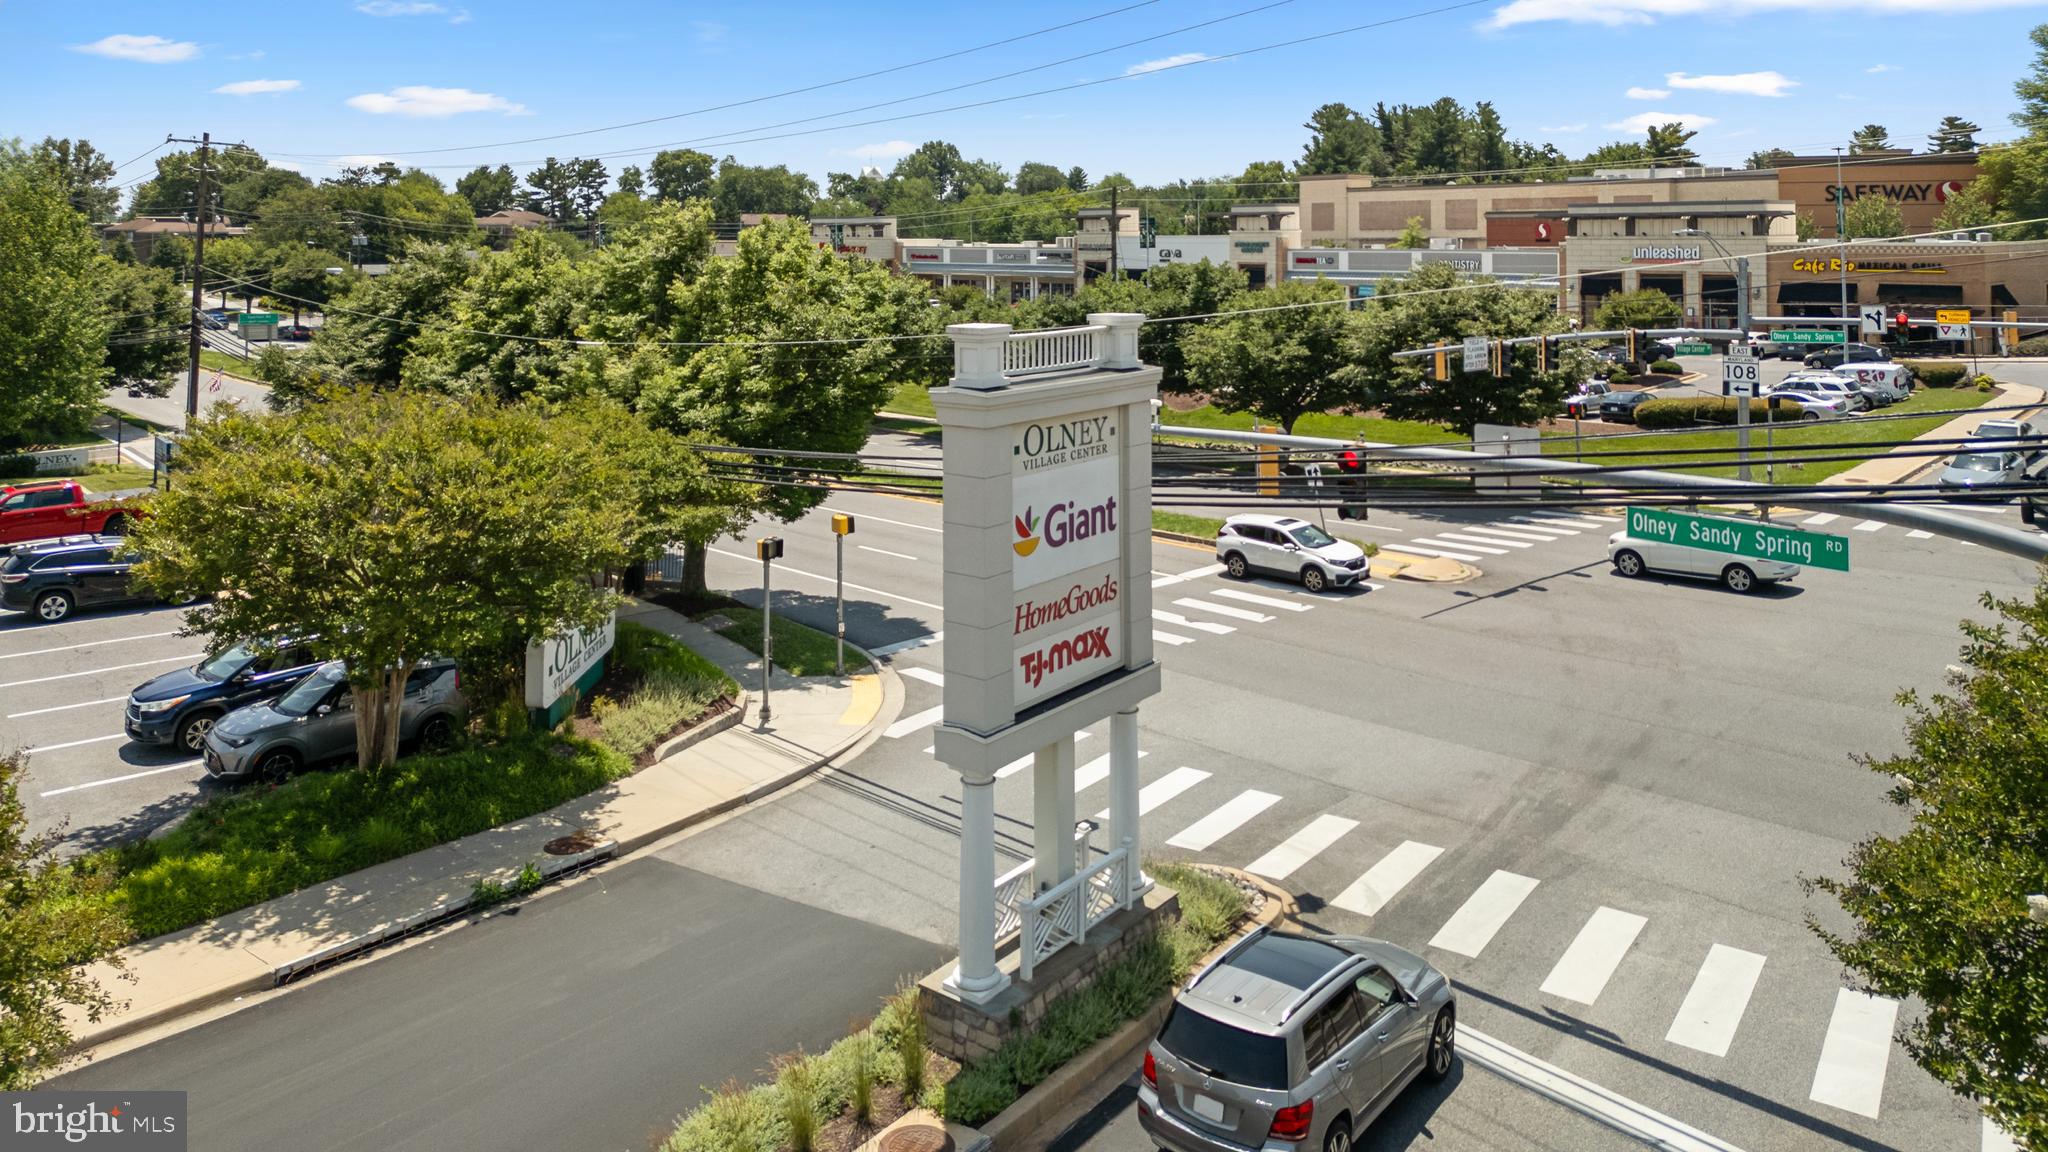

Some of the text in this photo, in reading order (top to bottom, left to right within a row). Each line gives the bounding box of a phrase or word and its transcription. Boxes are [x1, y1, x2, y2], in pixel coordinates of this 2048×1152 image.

[1825, 184, 1932, 202] SAFEWAY
[1159, 249, 1182, 258] cava
[1633, 245, 1700, 259] unleashed
[1793, 258, 1825, 274] Cafe
[1830, 258, 1856, 271] Rio
[1857, 261, 1907, 270] MEXICAN
[1773, 332, 1789, 341] Olney
[1793, 332, 1811, 341] Sandy
[1815, 332, 1835, 342] Spring
[1726, 364, 1756, 380] 108
[1857, 369, 1885, 383] Rio
[1023, 416, 1108, 457] OLNEY
[35, 454, 72, 464] LNEY
[1022, 444, 1108, 471] VILLAGE CENTER
[1044, 496, 1117, 548] Giant
[1633, 513, 1843, 563] Olney Sandy Spring RD
[1014, 574, 1118, 635] HomeGoods
[553, 635, 607, 688] VILLAGE CENTER
